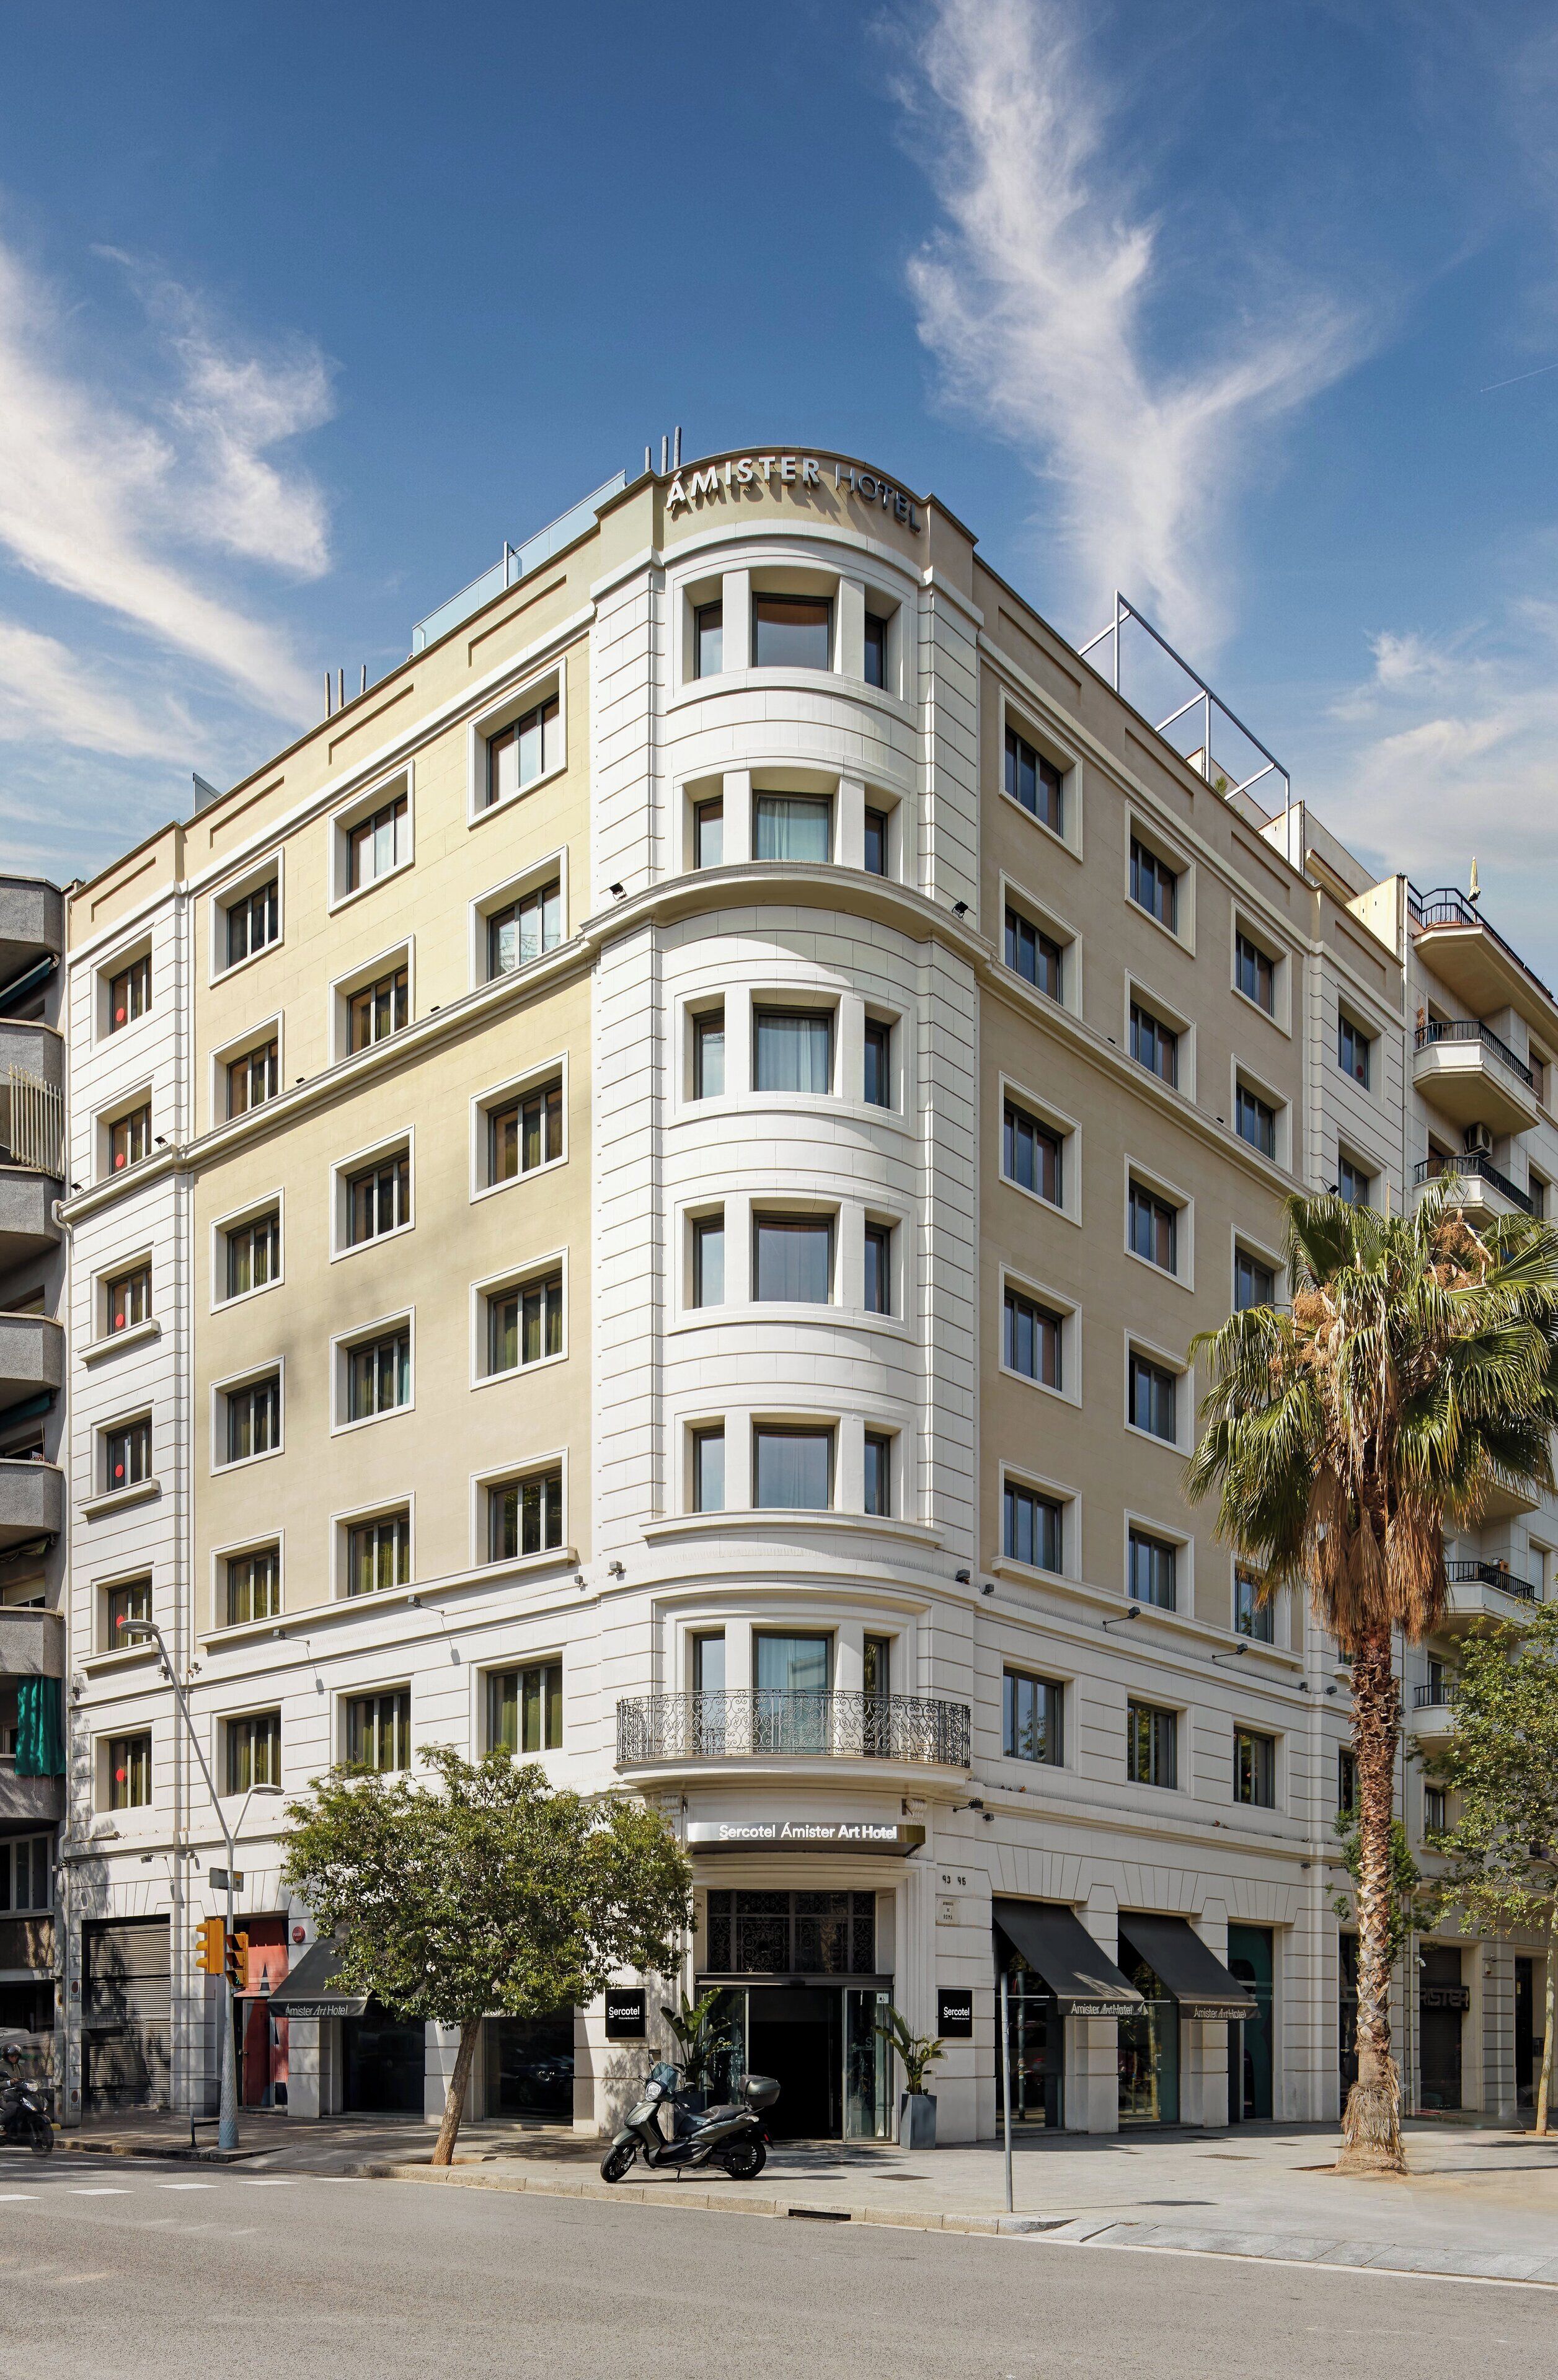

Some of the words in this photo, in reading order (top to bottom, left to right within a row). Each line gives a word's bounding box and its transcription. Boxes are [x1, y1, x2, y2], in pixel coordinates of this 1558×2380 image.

[666, 457, 820, 511] ÁMISTER
[836, 464, 921, 532] HOTEL
[719, 1824, 776, 1840] Sercotel
[780, 1822, 836, 1838] Ámister
[838, 1825, 861, 1838] Art
[862, 1825, 897, 1839] Hotel
[942, 1875, 951, 1884] 93
[957, 1876, 967, 1885] 95
[285, 2003, 313, 2016] Ámister
[312, 2005, 327, 2016] Art
[327, 2004, 348, 2016] Hotel
[609, 2006, 640, 2017] Sercotel
[944, 2006, 969, 2017] Sercotel
[1070, 2000, 1099, 2015] Ámister
[1113, 2004, 1134, 2015] Hotel
[1193, 2005, 1218, 2019] Ámister
[1218, 2008, 1228, 2019] Art
[1228, 2009, 1247, 2019] Hotel
